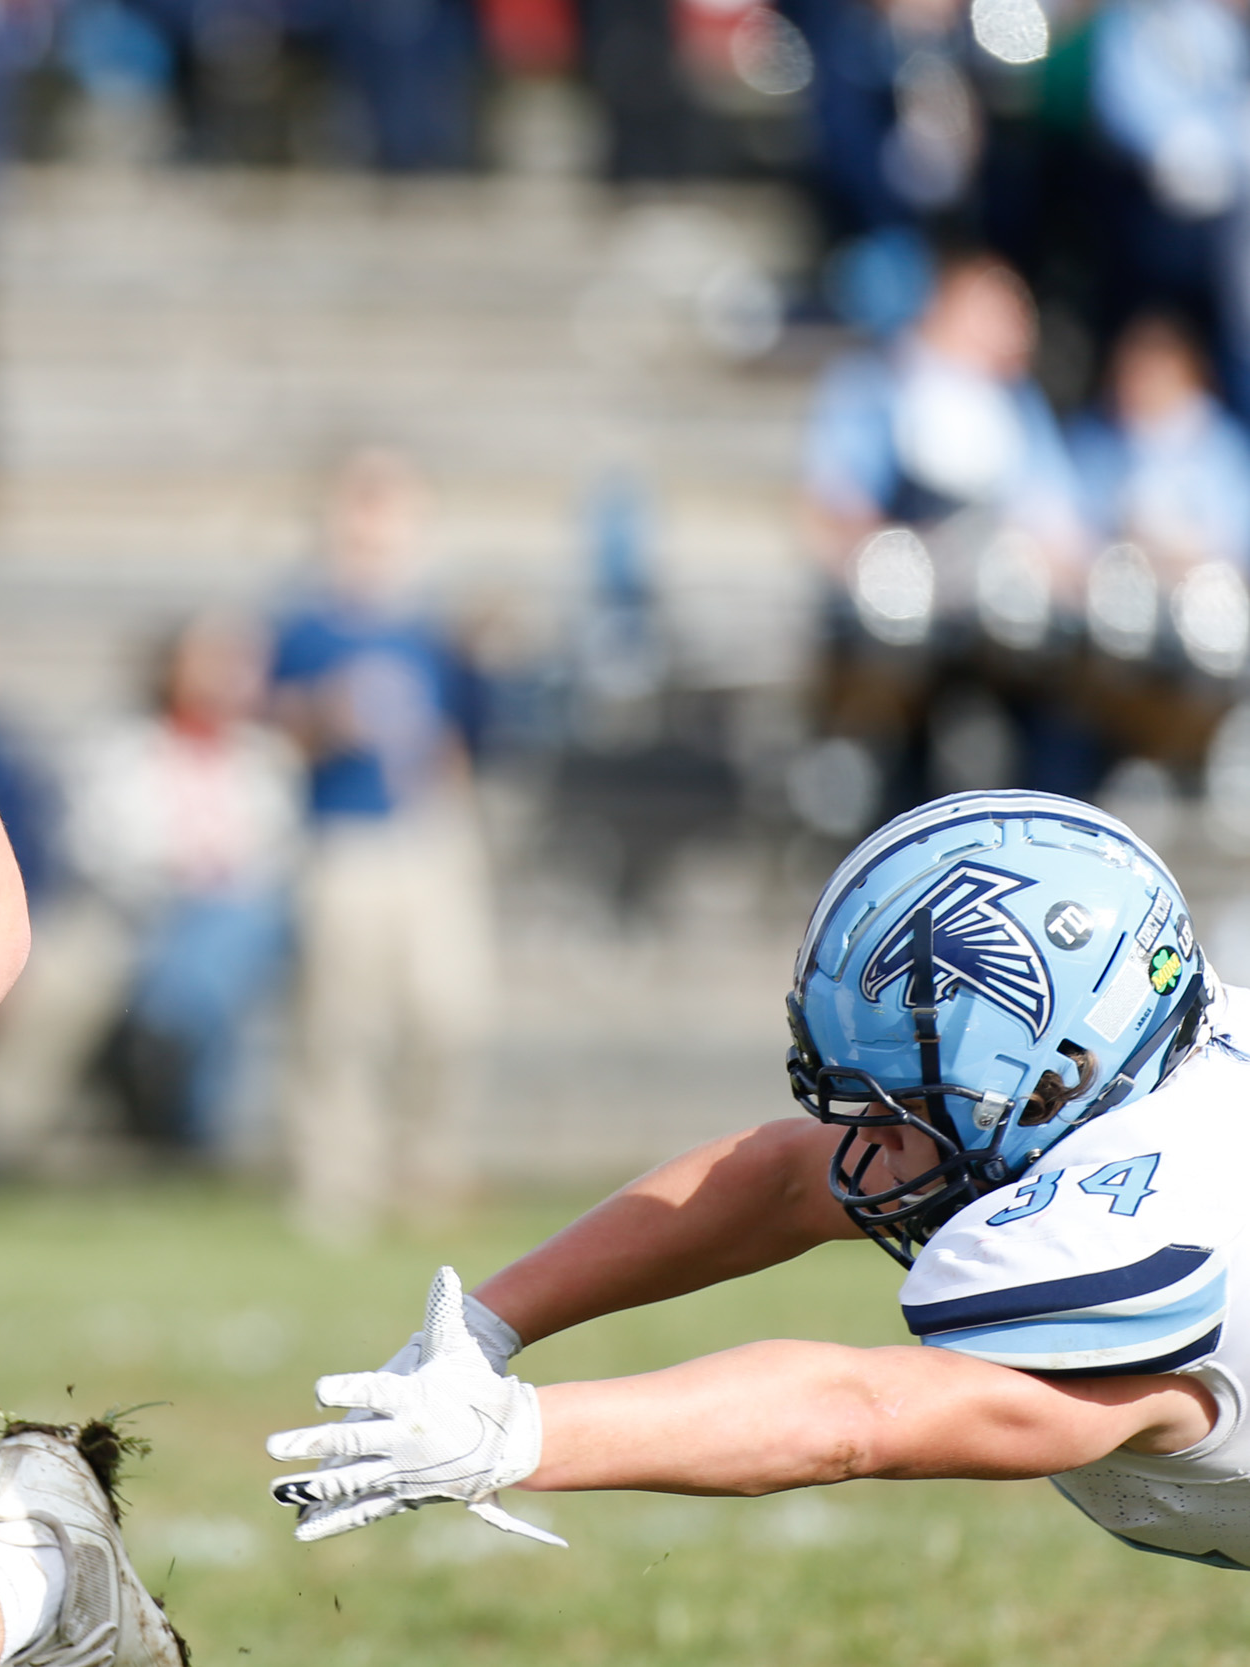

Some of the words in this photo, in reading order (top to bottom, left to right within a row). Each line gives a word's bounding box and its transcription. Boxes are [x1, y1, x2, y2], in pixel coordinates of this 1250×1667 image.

[1047, 905, 1089, 945] TD
[1150, 952, 1182, 992] MOM
[985, 1151, 1162, 1227] 34
